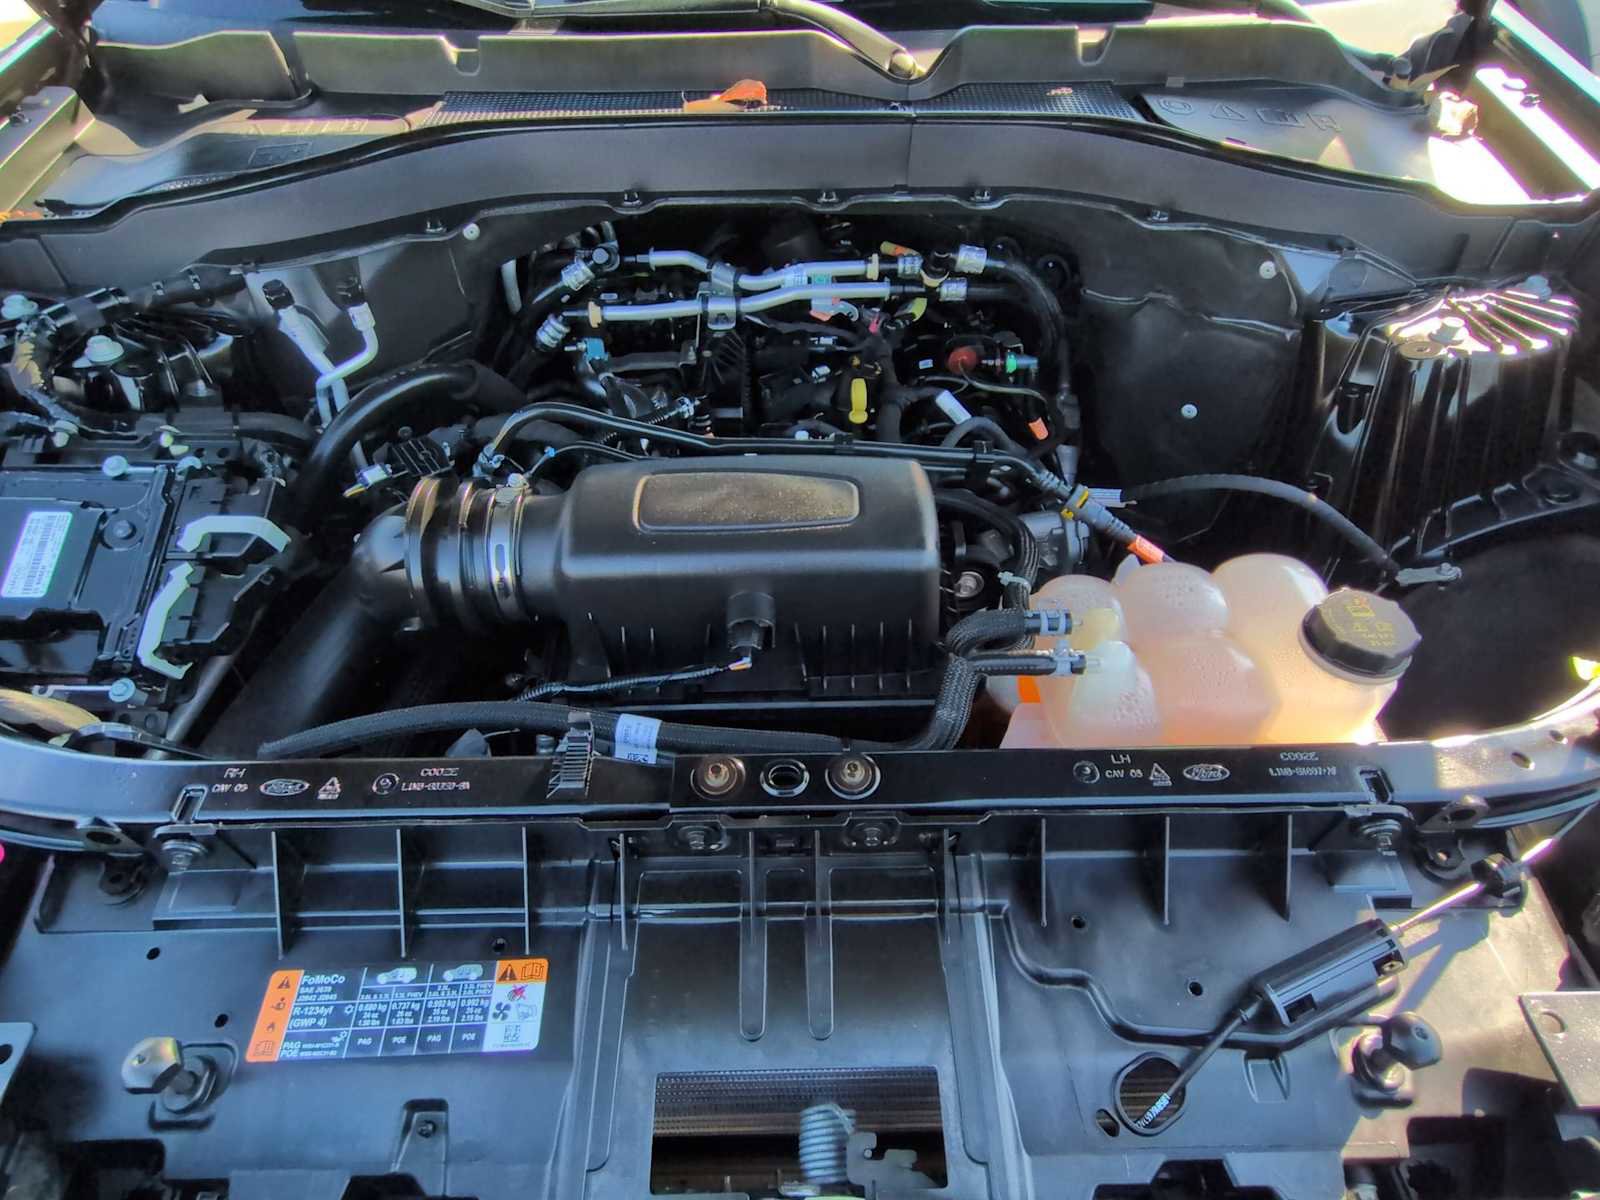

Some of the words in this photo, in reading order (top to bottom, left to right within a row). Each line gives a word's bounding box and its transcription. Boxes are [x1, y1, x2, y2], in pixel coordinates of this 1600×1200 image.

[1110, 754, 1131, 764] LH
[224, 767, 246, 778] RH
[1187, 765, 1226, 780] Ford
[302, 974, 346, 985] FoMoCo
[293, 1005, 335, 1017] R-1234yf
[391, 1002, 410, 1010] 0.737
[288, 1018, 317, 1030] (GWP
[318, 1017, 328, 1028] 4)
[357, 1037, 373, 1046] PAG
[426, 1034, 442, 1042] PAG
[283, 1041, 301, 1050] PAG
[280, 1049, 298, 1058] POE
